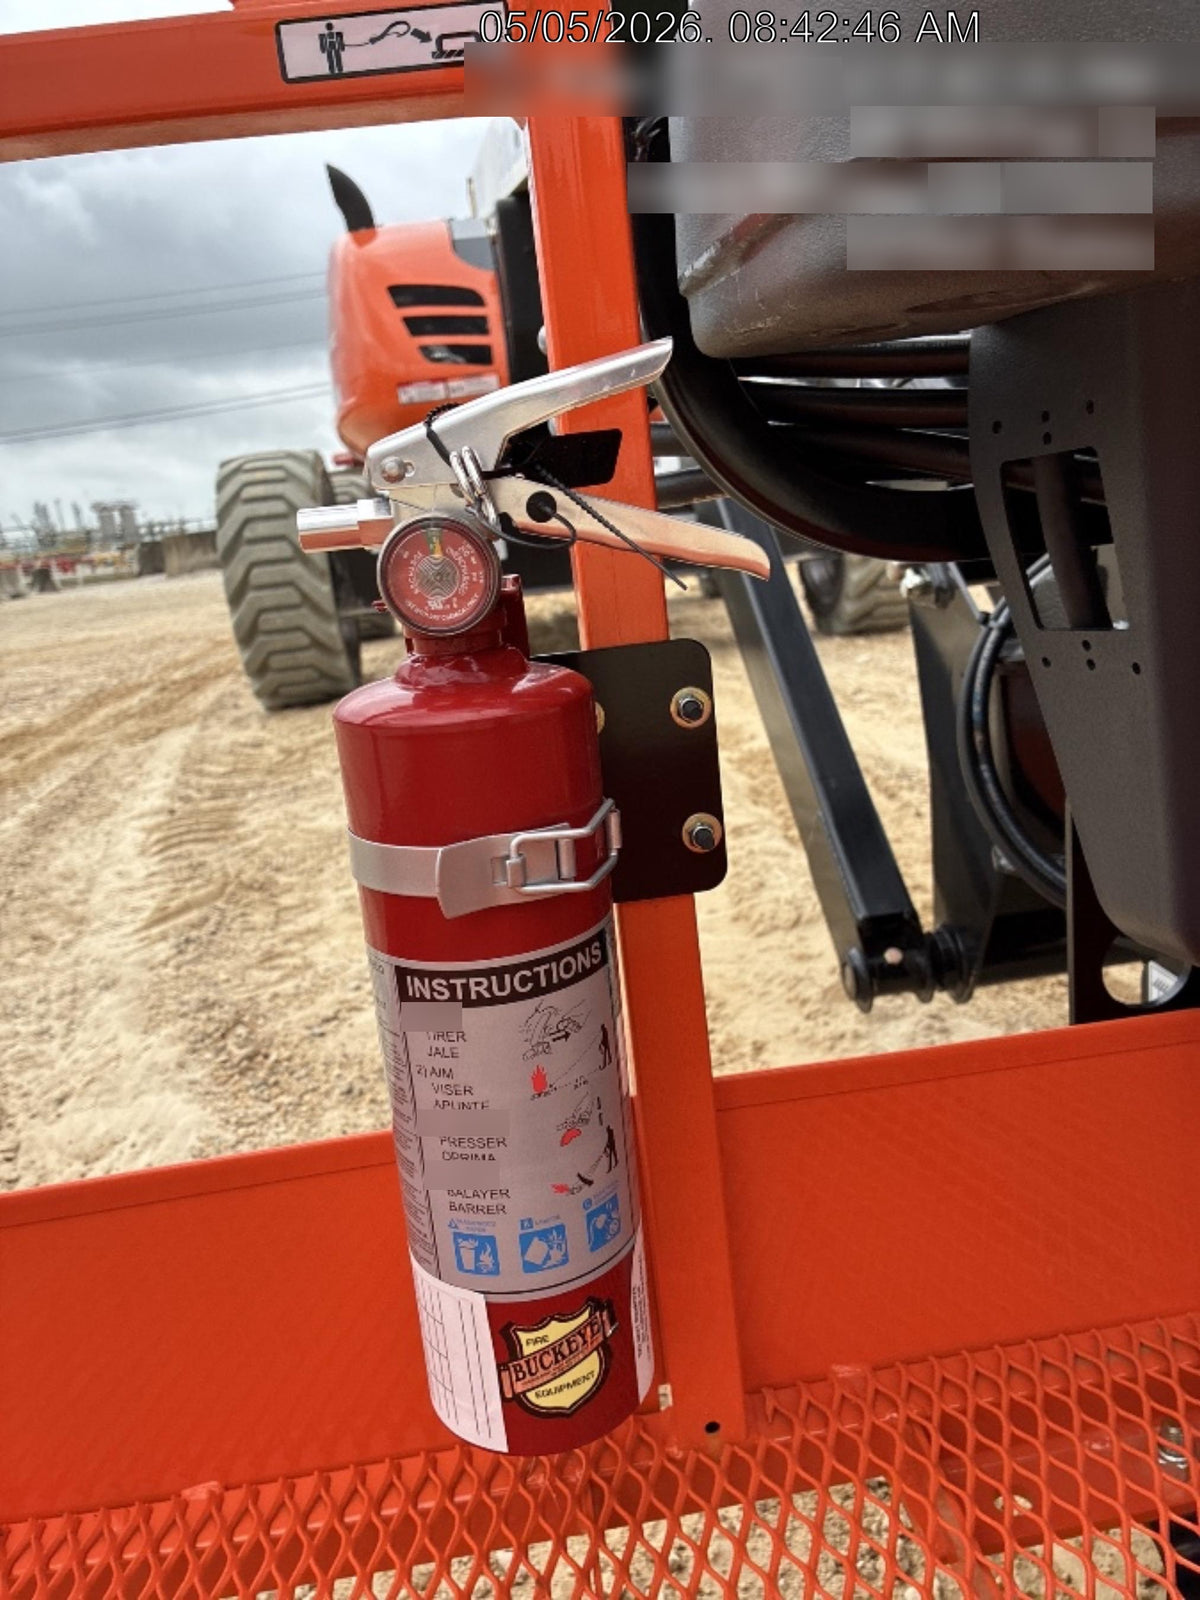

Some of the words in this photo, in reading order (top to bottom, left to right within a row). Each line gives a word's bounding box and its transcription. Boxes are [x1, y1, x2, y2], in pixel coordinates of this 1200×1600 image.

[406, 941, 602, 1000] INSTRUCTIONS
[427, 1046, 460, 1058] JALE
[430, 1066, 454, 1080] AIM
[431, 1082, 474, 1096] VISER
[433, 1100, 490, 1110] APUNTE
[440, 1136, 507, 1149] PRESSER
[447, 1189, 511, 1199] BALAYER
[449, 1201, 507, 1215] BARRER
[525, 1335, 550, 1347] FIRE
[511, 1316, 602, 1382] BUCKEYE
[534, 1370, 595, 1399] EQUIPMENT
